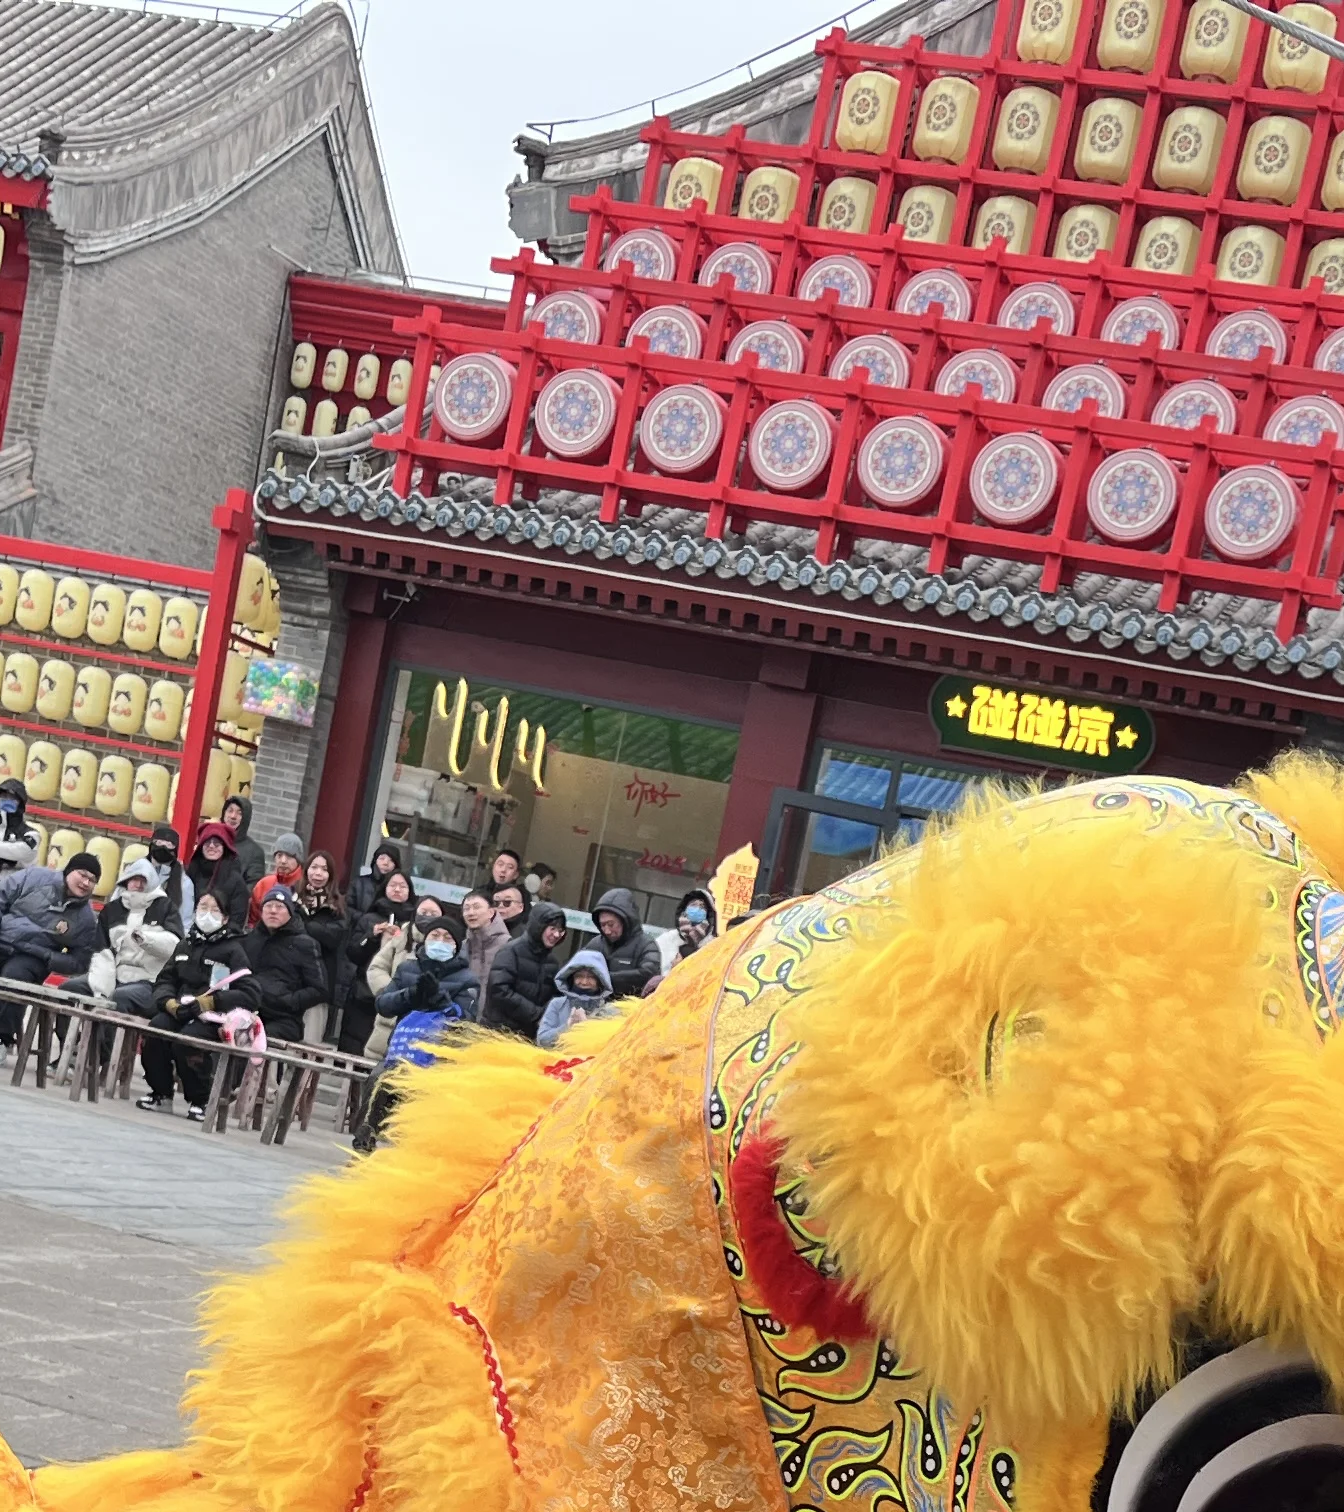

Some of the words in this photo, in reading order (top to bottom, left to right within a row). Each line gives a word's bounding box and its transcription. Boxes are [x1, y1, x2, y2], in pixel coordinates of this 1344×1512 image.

[967, 684, 1114, 757] 碰碰凉
[624, 771, 681, 818] 你好
